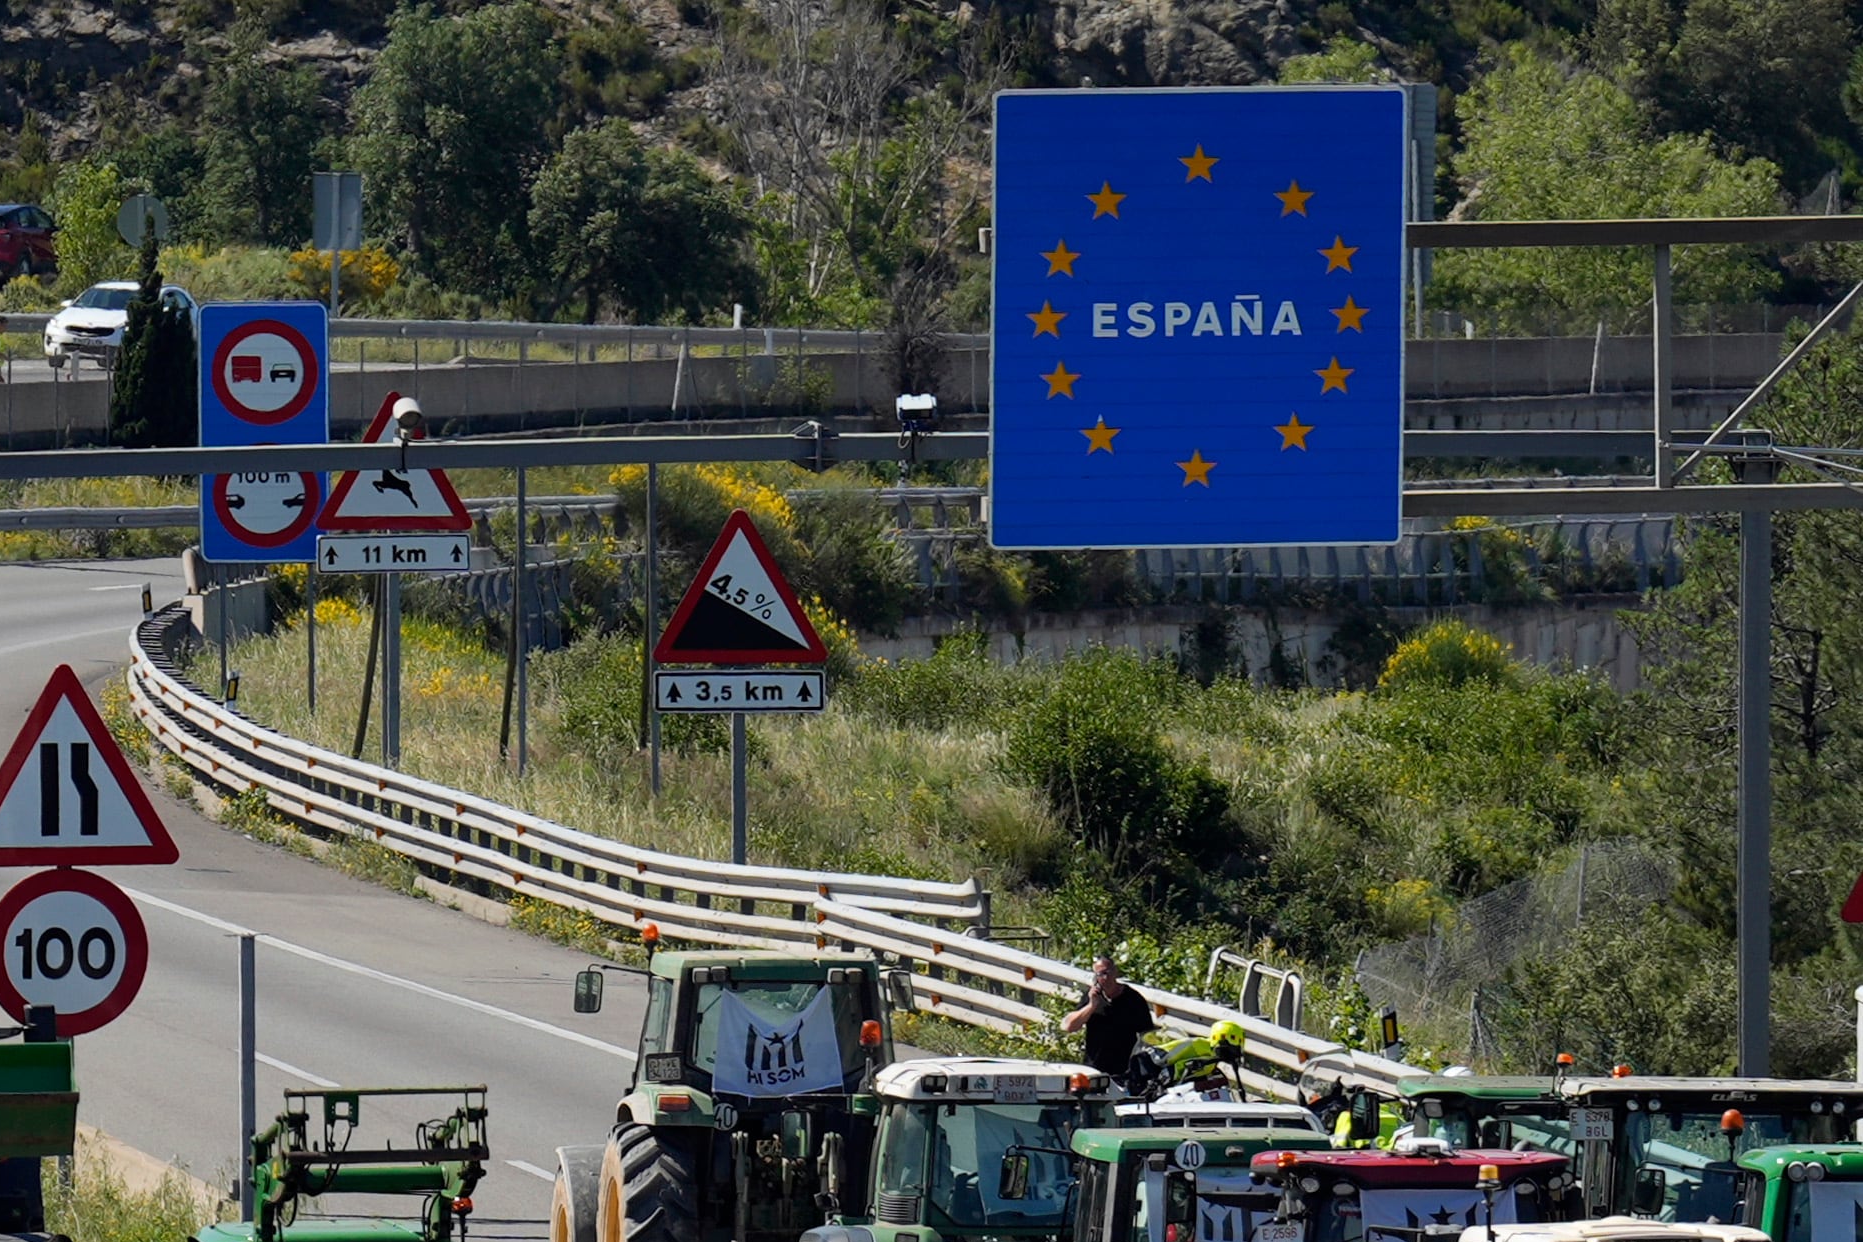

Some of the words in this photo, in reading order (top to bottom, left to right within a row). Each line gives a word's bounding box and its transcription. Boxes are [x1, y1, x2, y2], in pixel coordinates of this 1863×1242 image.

[1092, 294, 1302, 338] ESPAÑA
[362, 545, 381, 563] 11
[392, 545, 426, 563] km
[695, 680, 733, 704] 3,5
[745, 680, 783, 701] km
[15, 926, 116, 980] 100
[747, 1068, 763, 1085] HI
[767, 1066, 806, 1085] SOM
[1183, 1144, 1200, 1168] 40
